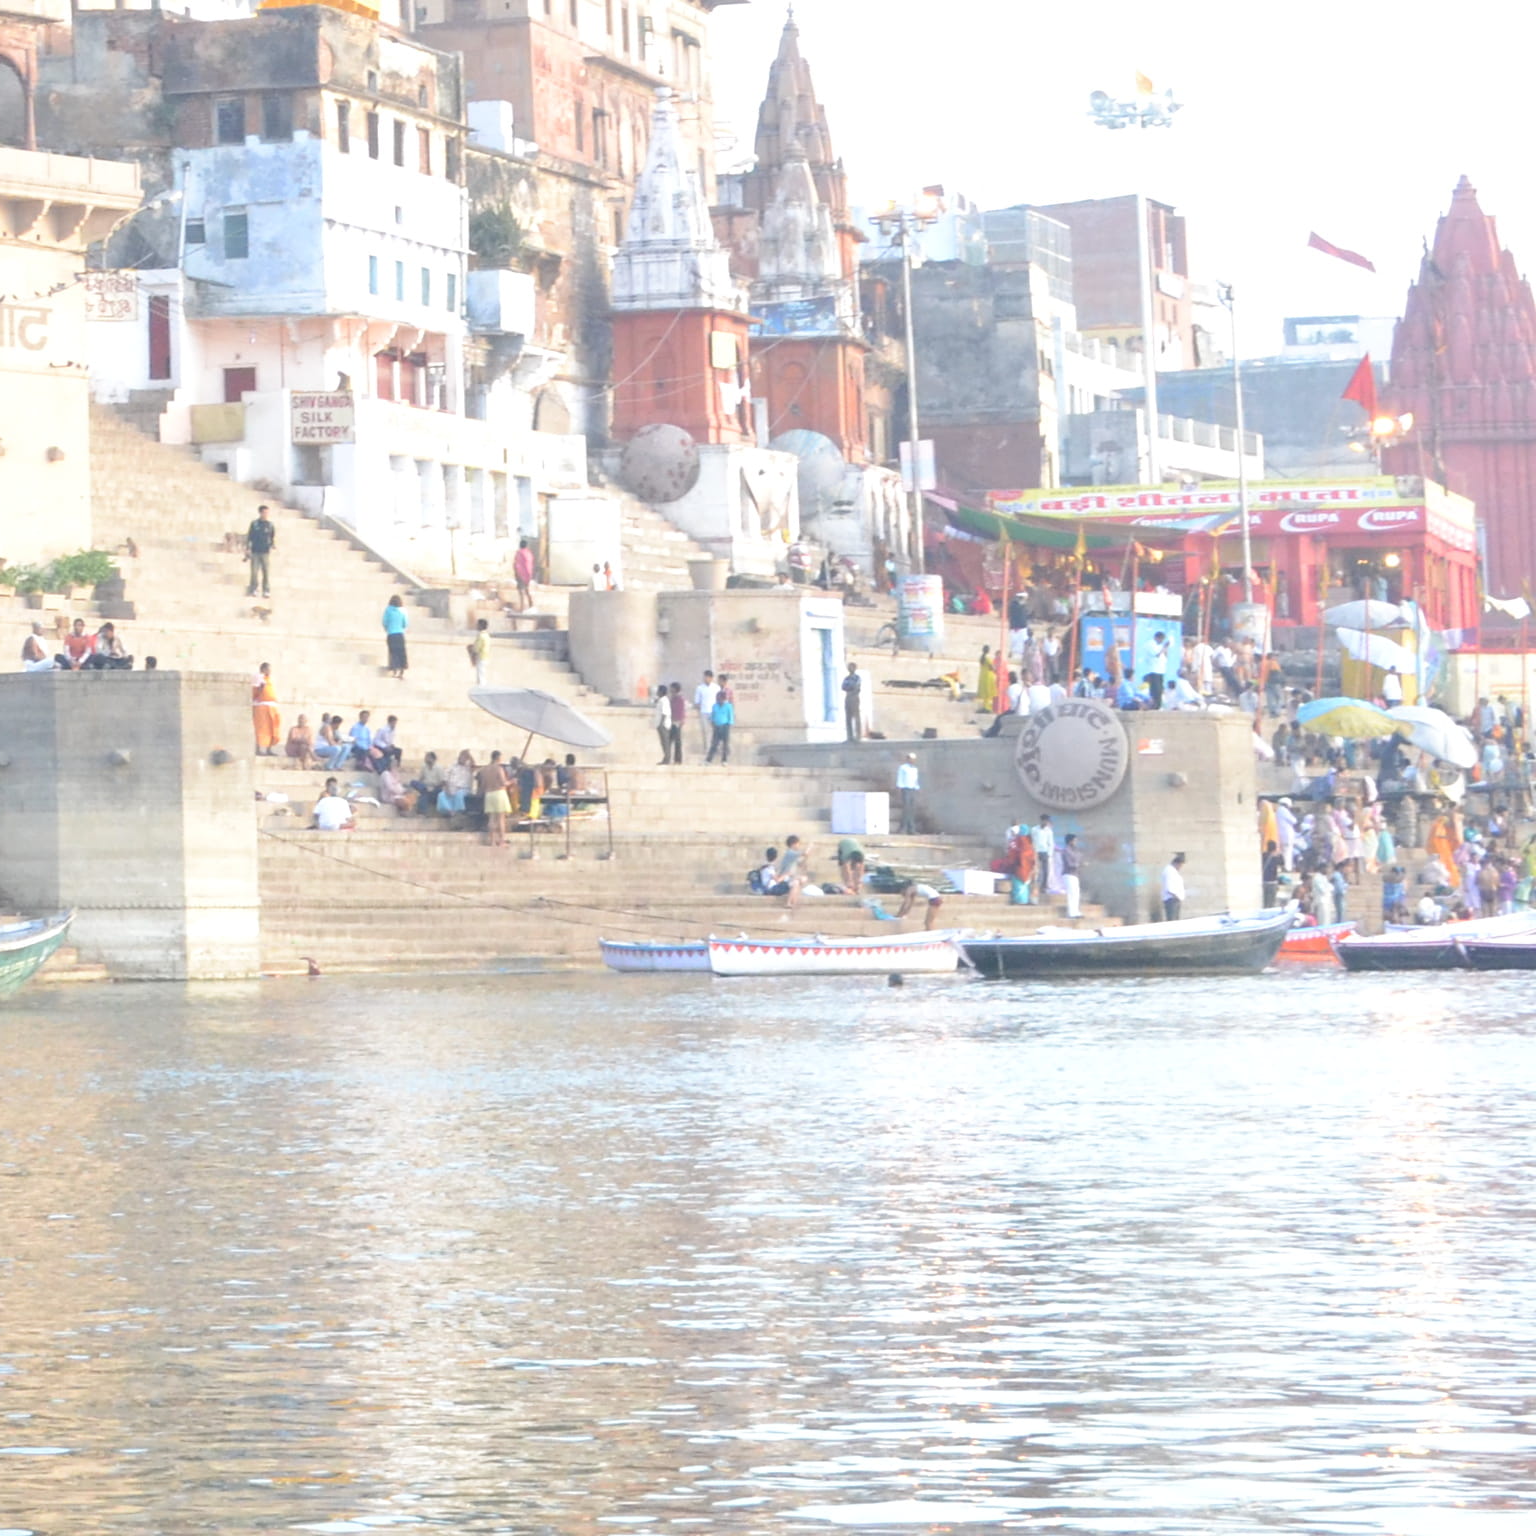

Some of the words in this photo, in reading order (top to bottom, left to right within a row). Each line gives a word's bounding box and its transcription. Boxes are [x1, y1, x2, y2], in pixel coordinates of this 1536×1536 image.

[301, 411, 333, 424] SILK
[295, 425, 350, 438] FACTORY
[1295, 512, 1340, 523] RUPA
[1372, 510, 1419, 521] RUPA
